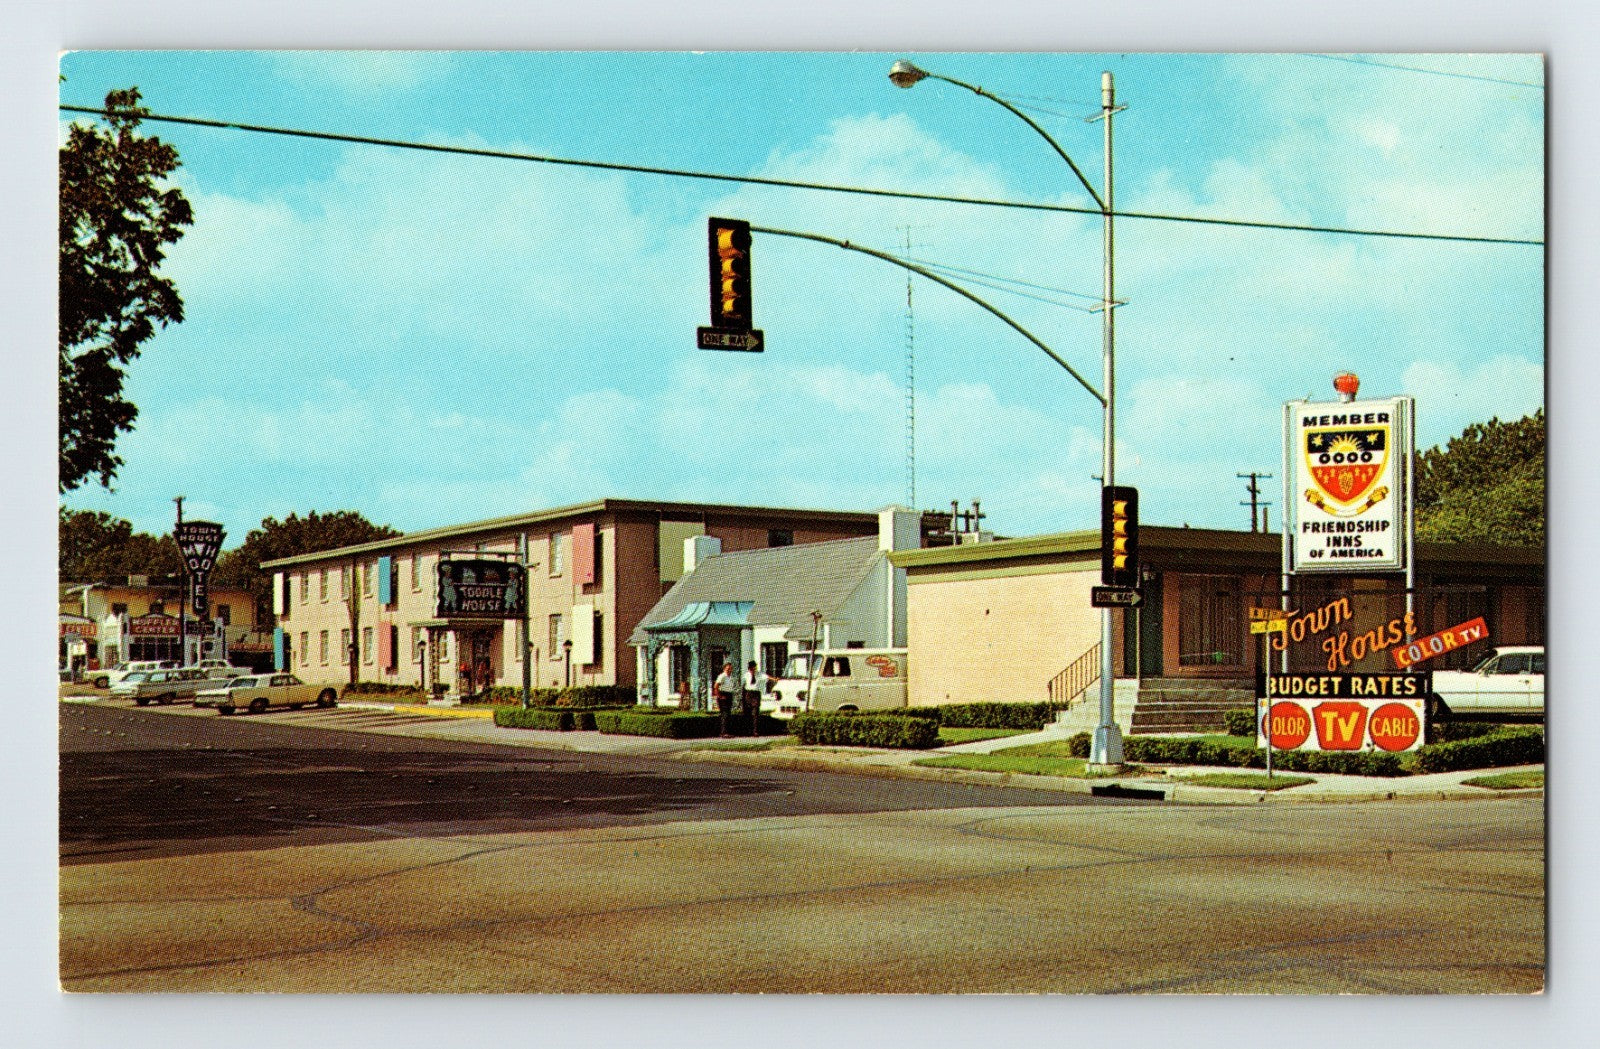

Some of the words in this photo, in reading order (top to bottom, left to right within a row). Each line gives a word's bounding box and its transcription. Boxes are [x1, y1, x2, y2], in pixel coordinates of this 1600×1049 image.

[704, 334, 723, 345] ONE
[728, 335, 748, 347] WAY
[1303, 413, 1389, 427] MEMBER
[182, 526, 218, 534] TOWN
[1303, 520, 1390, 533] FRIENDSHIP
[1326, 535, 1362, 547] INNS
[1310, 549, 1324, 558] OF
[1330, 548, 1383, 558] AMERICA
[1096, 591, 1113, 602] ONE
[1115, 592, 1132, 602] WAY
[462, 599, 501, 611] HOUSE
[1272, 597, 1352, 650] Town
[1322, 611, 1417, 672] House
[1398, 629, 1458, 665] COLOR
[1460, 625, 1481, 643] TV
[1270, 676, 1342, 695] BUDGET
[1351, 676, 1416, 695] RATES
[1321, 711, 1360, 742] TV
[1371, 717, 1415, 737] CABLE
